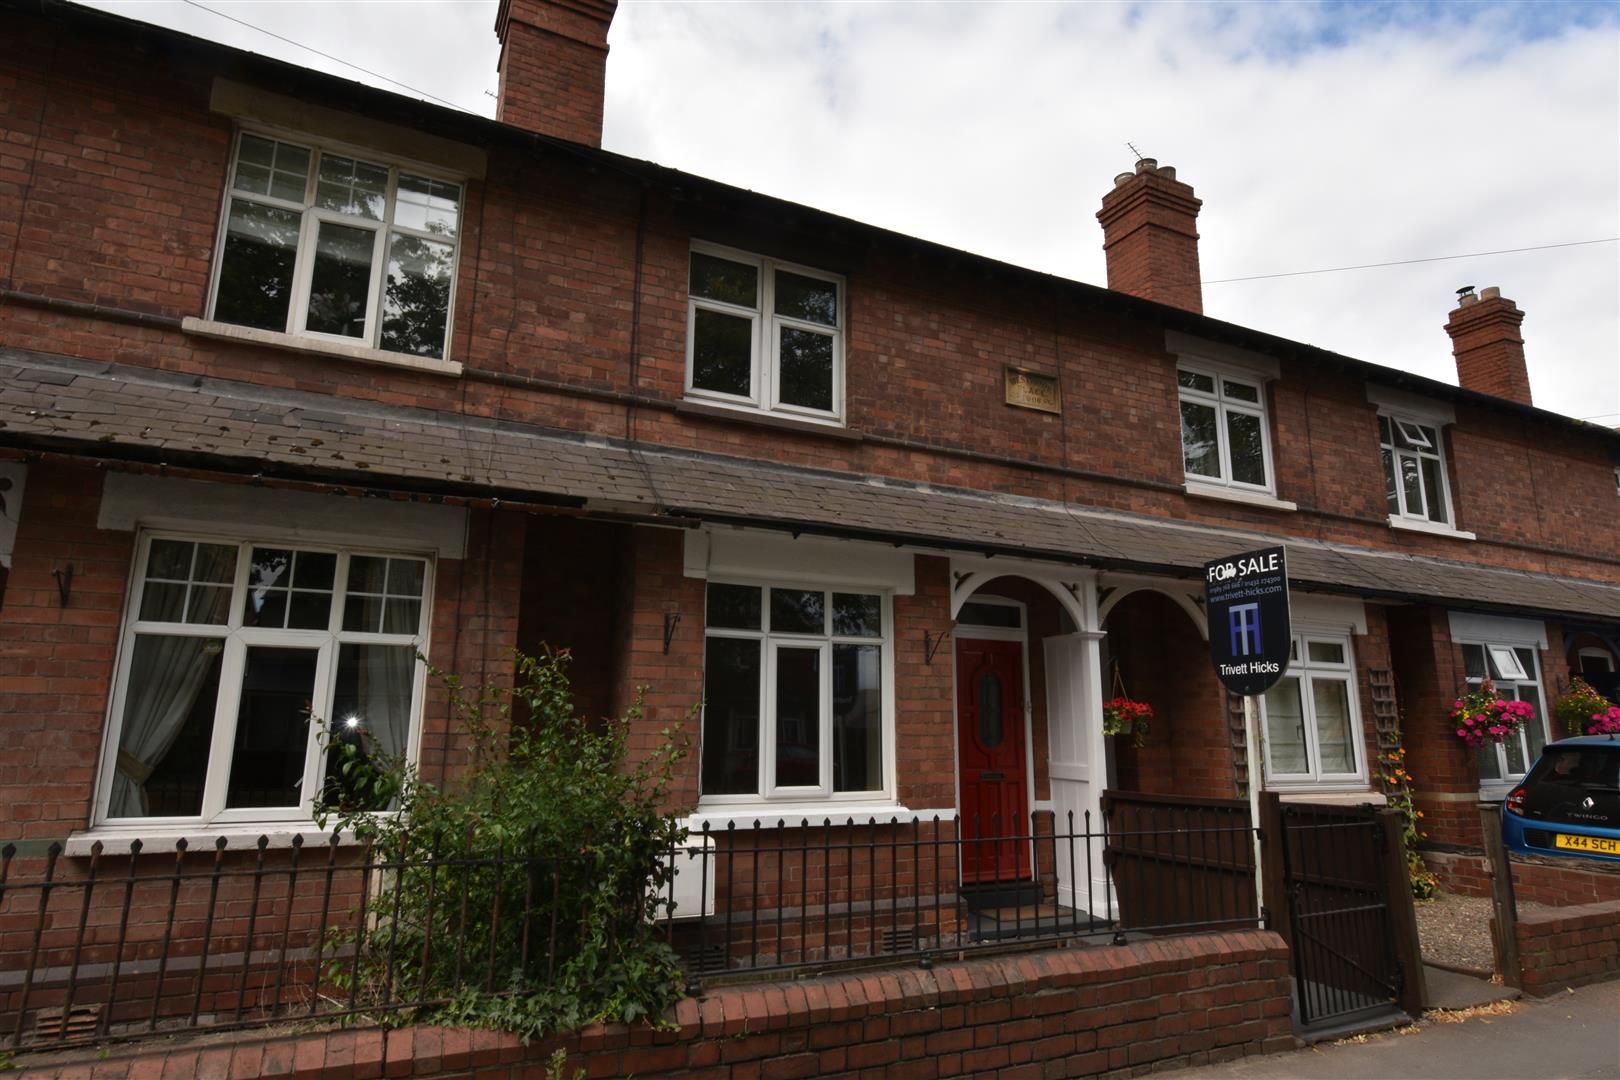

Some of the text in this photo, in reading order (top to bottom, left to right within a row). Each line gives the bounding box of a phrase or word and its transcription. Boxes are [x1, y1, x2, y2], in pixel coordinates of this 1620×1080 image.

[1209, 553, 1279, 583] FOR SALE
[1210, 585, 1282, 603] www.trivett-hicks.com
[1220, 661, 1279, 676] Trivett Hicks
[1566, 812, 1608, 821] TWINGO
[1564, 835, 1616, 852] X44 SCH
